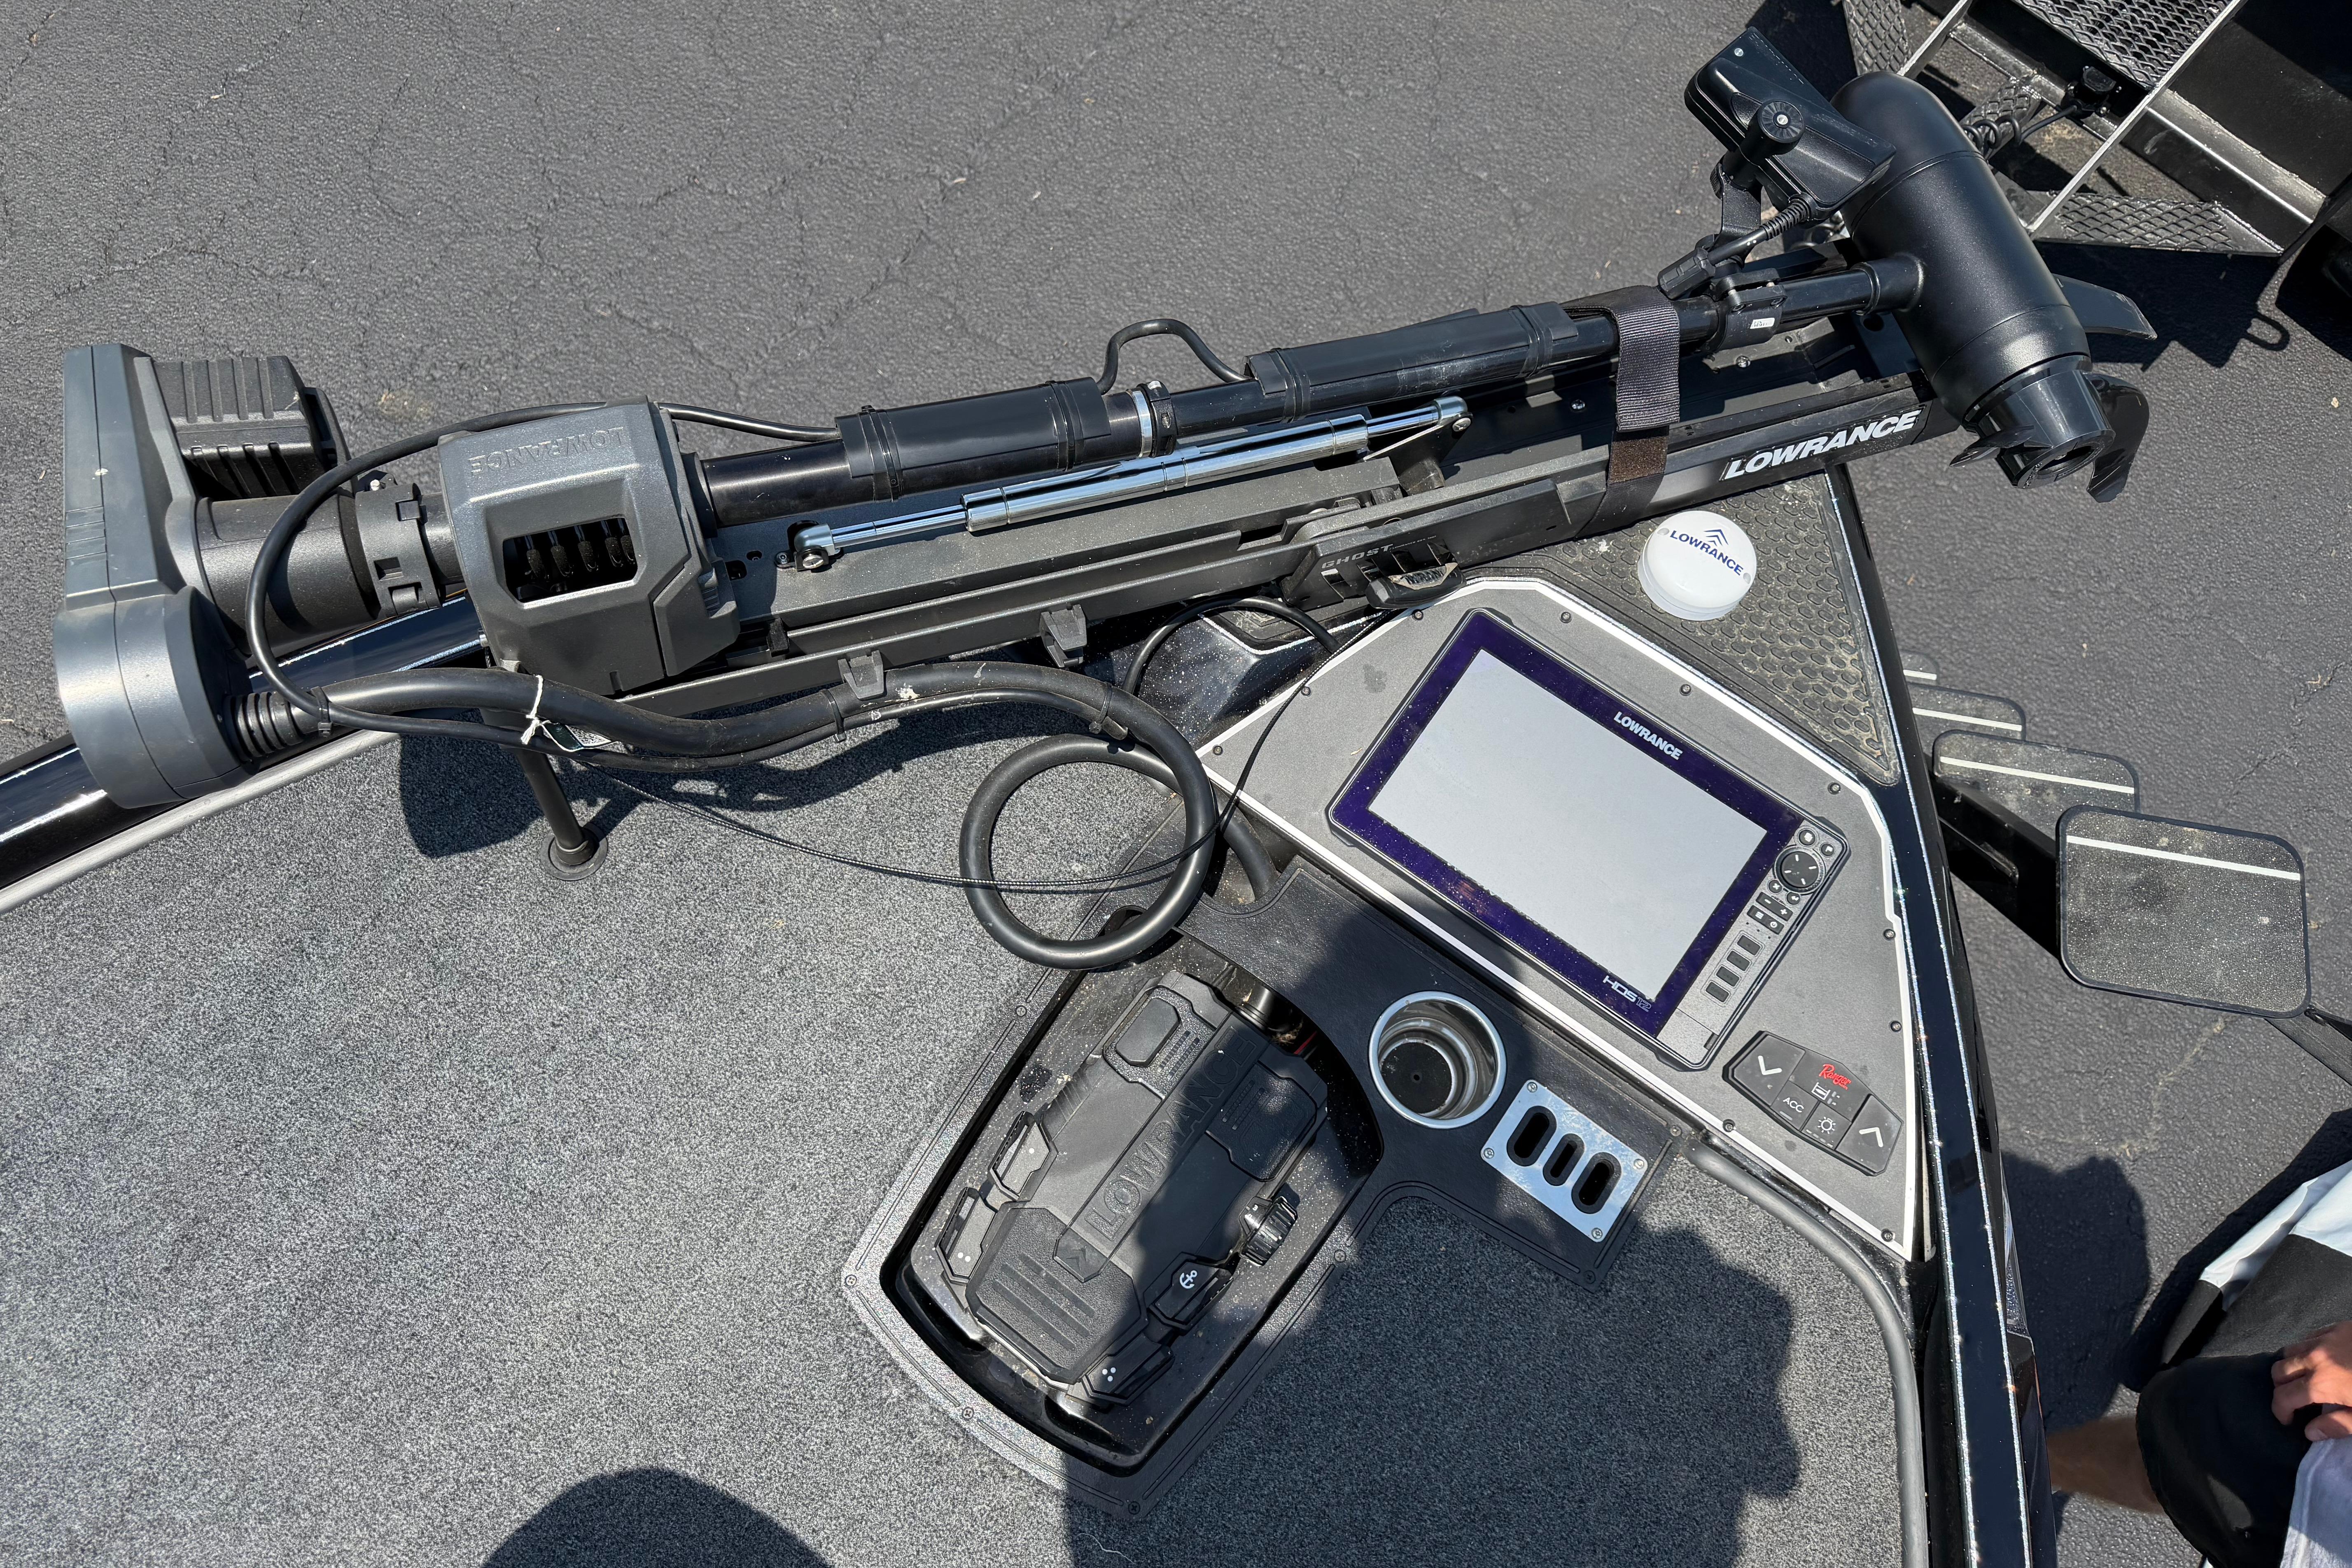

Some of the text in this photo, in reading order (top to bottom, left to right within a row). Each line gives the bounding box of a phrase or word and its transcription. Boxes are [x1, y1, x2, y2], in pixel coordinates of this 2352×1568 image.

[468, 427, 624, 473] LOWRANCE
[1724, 410, 1922, 480] LOWRANCE
[1321, 544, 1393, 569] GHOST
[1670, 530, 1744, 576] LOWRANCE
[1614, 712, 1683, 760] LOWRANCE
[1818, 1064, 1852, 1086] Ranger
[1783, 1097, 1804, 1113] ACC
[1084, 1026, 1257, 1241] LOWRANCE
